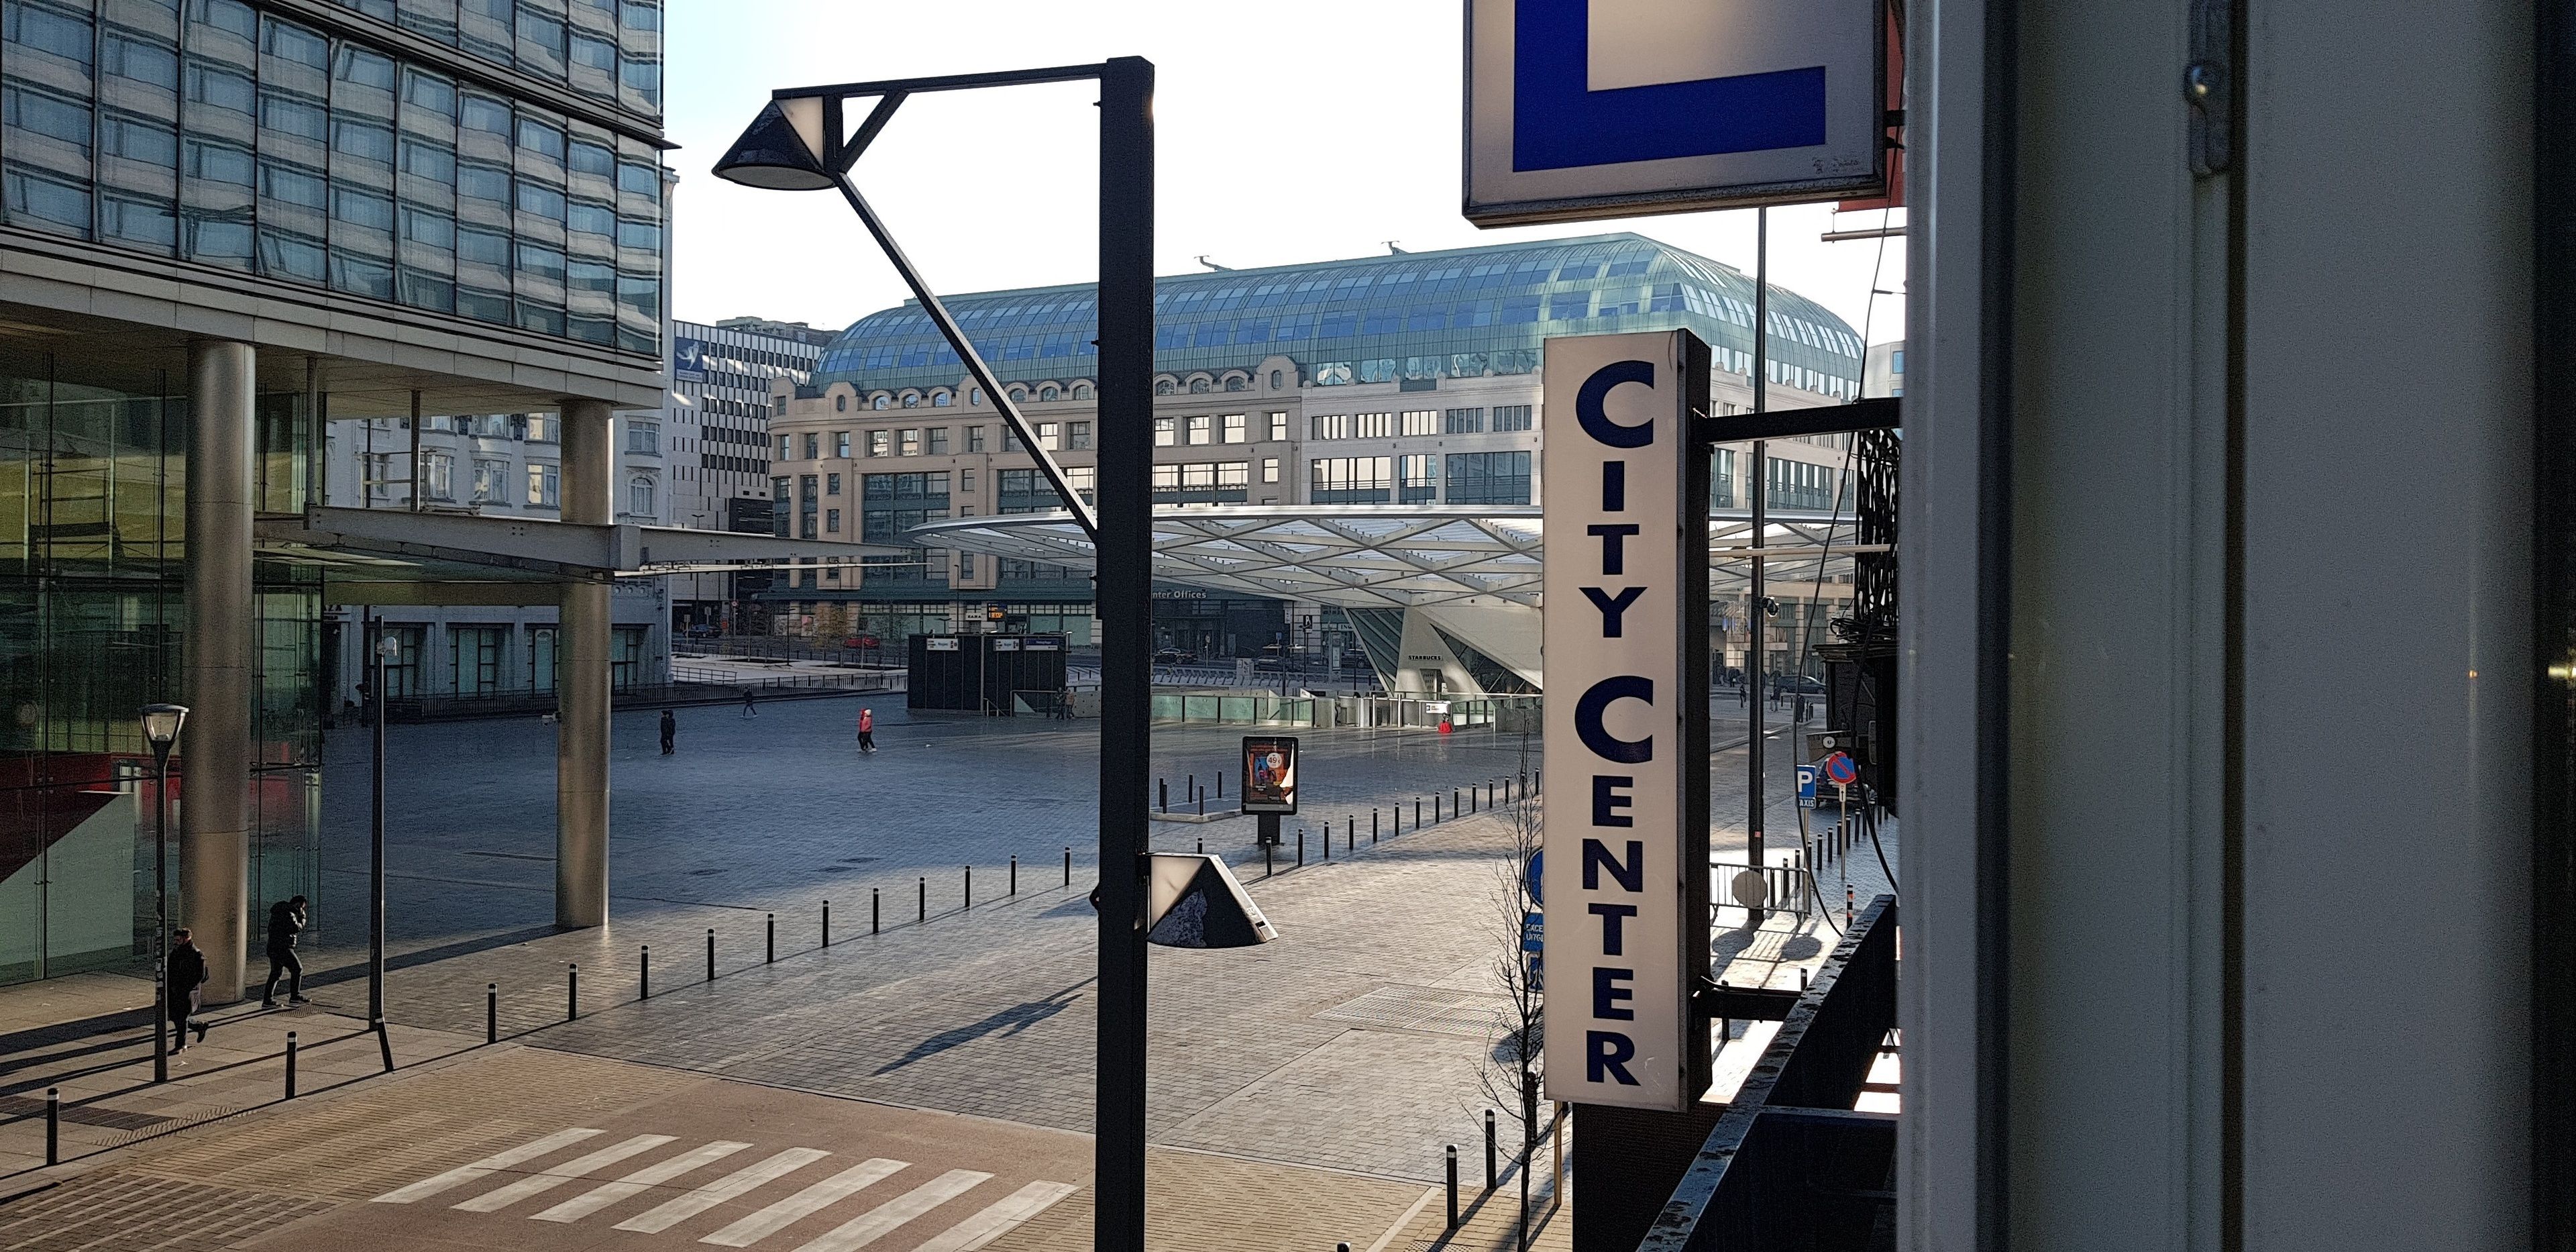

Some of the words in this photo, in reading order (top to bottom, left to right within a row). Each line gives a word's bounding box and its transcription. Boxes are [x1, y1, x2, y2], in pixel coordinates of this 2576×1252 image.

[1576, 360, 1654, 638] CITY
[1173, 590, 1206, 598] Offices
[1797, 771, 1813, 792] P
[1799, 799, 1814, 807] AXIS
[1574, 675, 1654, 1087] CENTER
